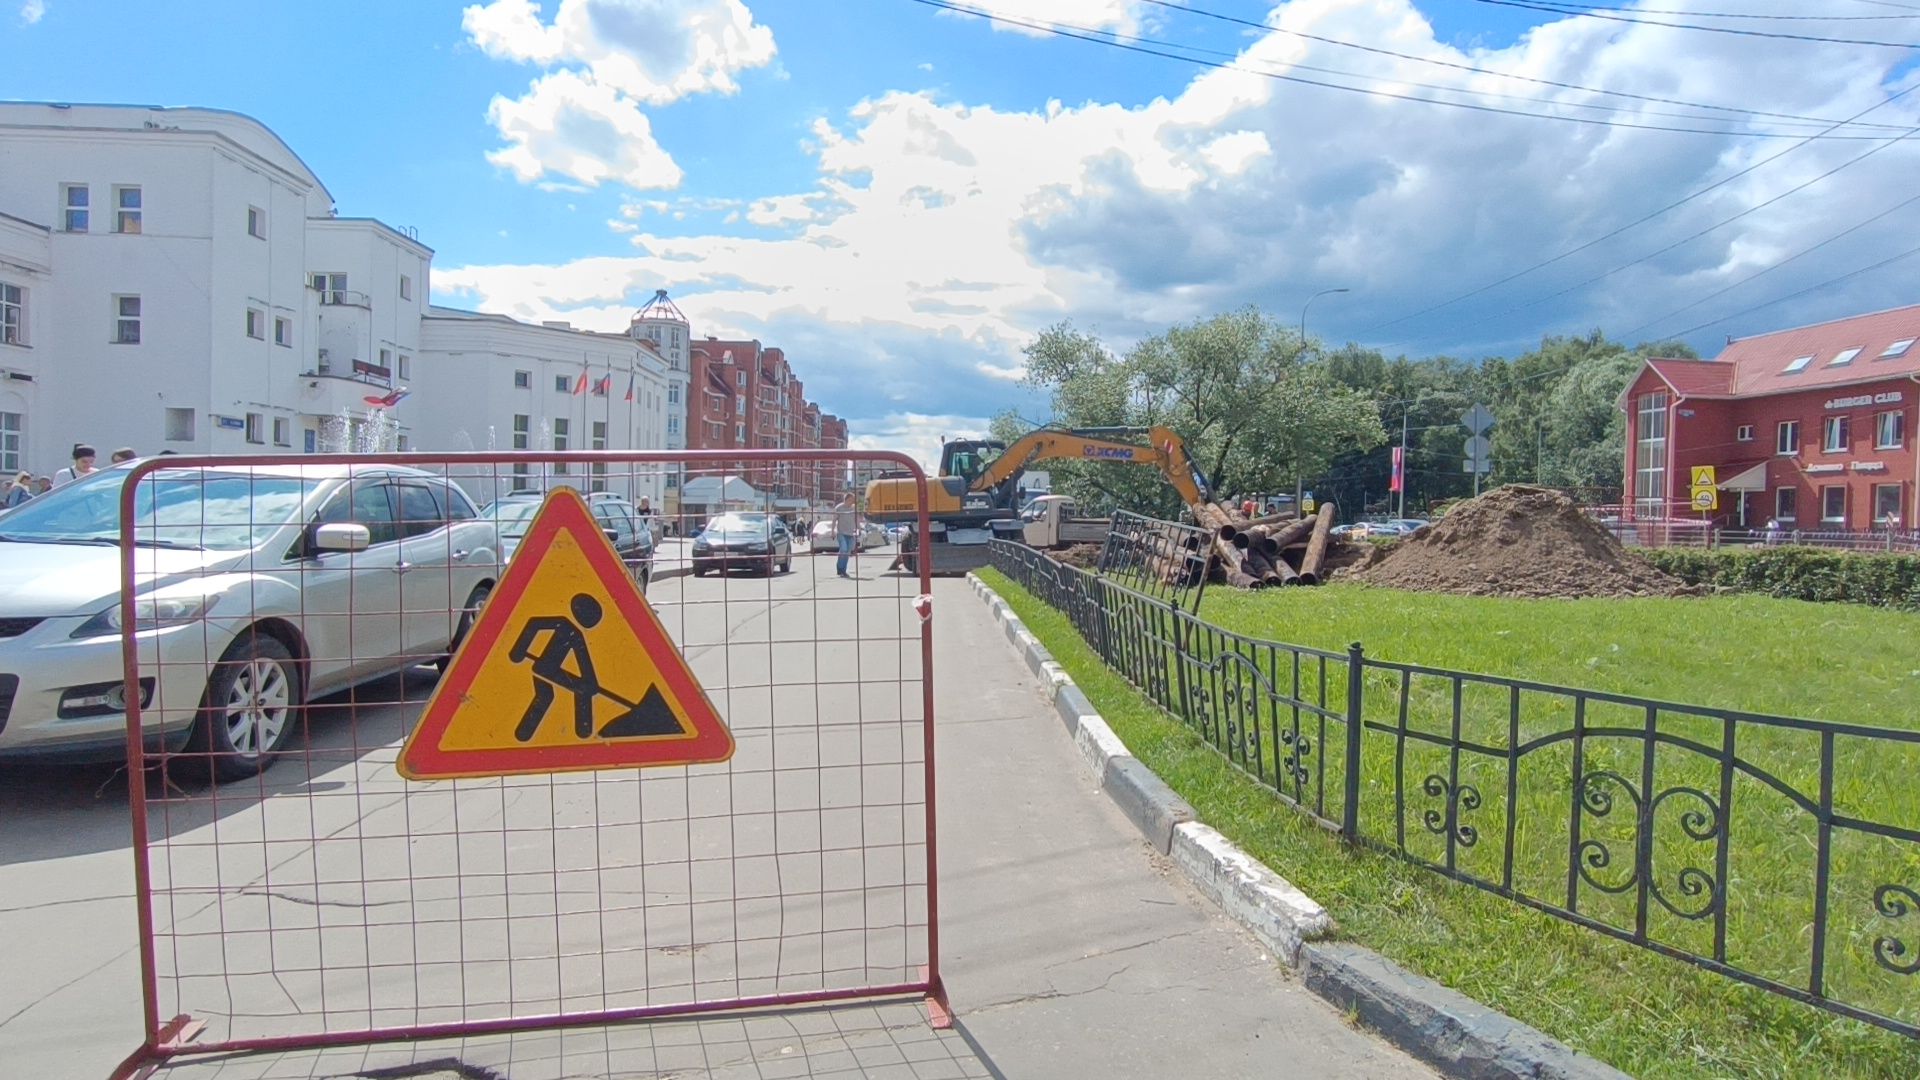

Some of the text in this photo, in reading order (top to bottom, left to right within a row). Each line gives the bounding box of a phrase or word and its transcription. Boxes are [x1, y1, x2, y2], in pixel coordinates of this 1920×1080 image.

[1833, 392, 1902, 408] BURGER CLUB
[1098, 447, 1133, 459] XCMG
